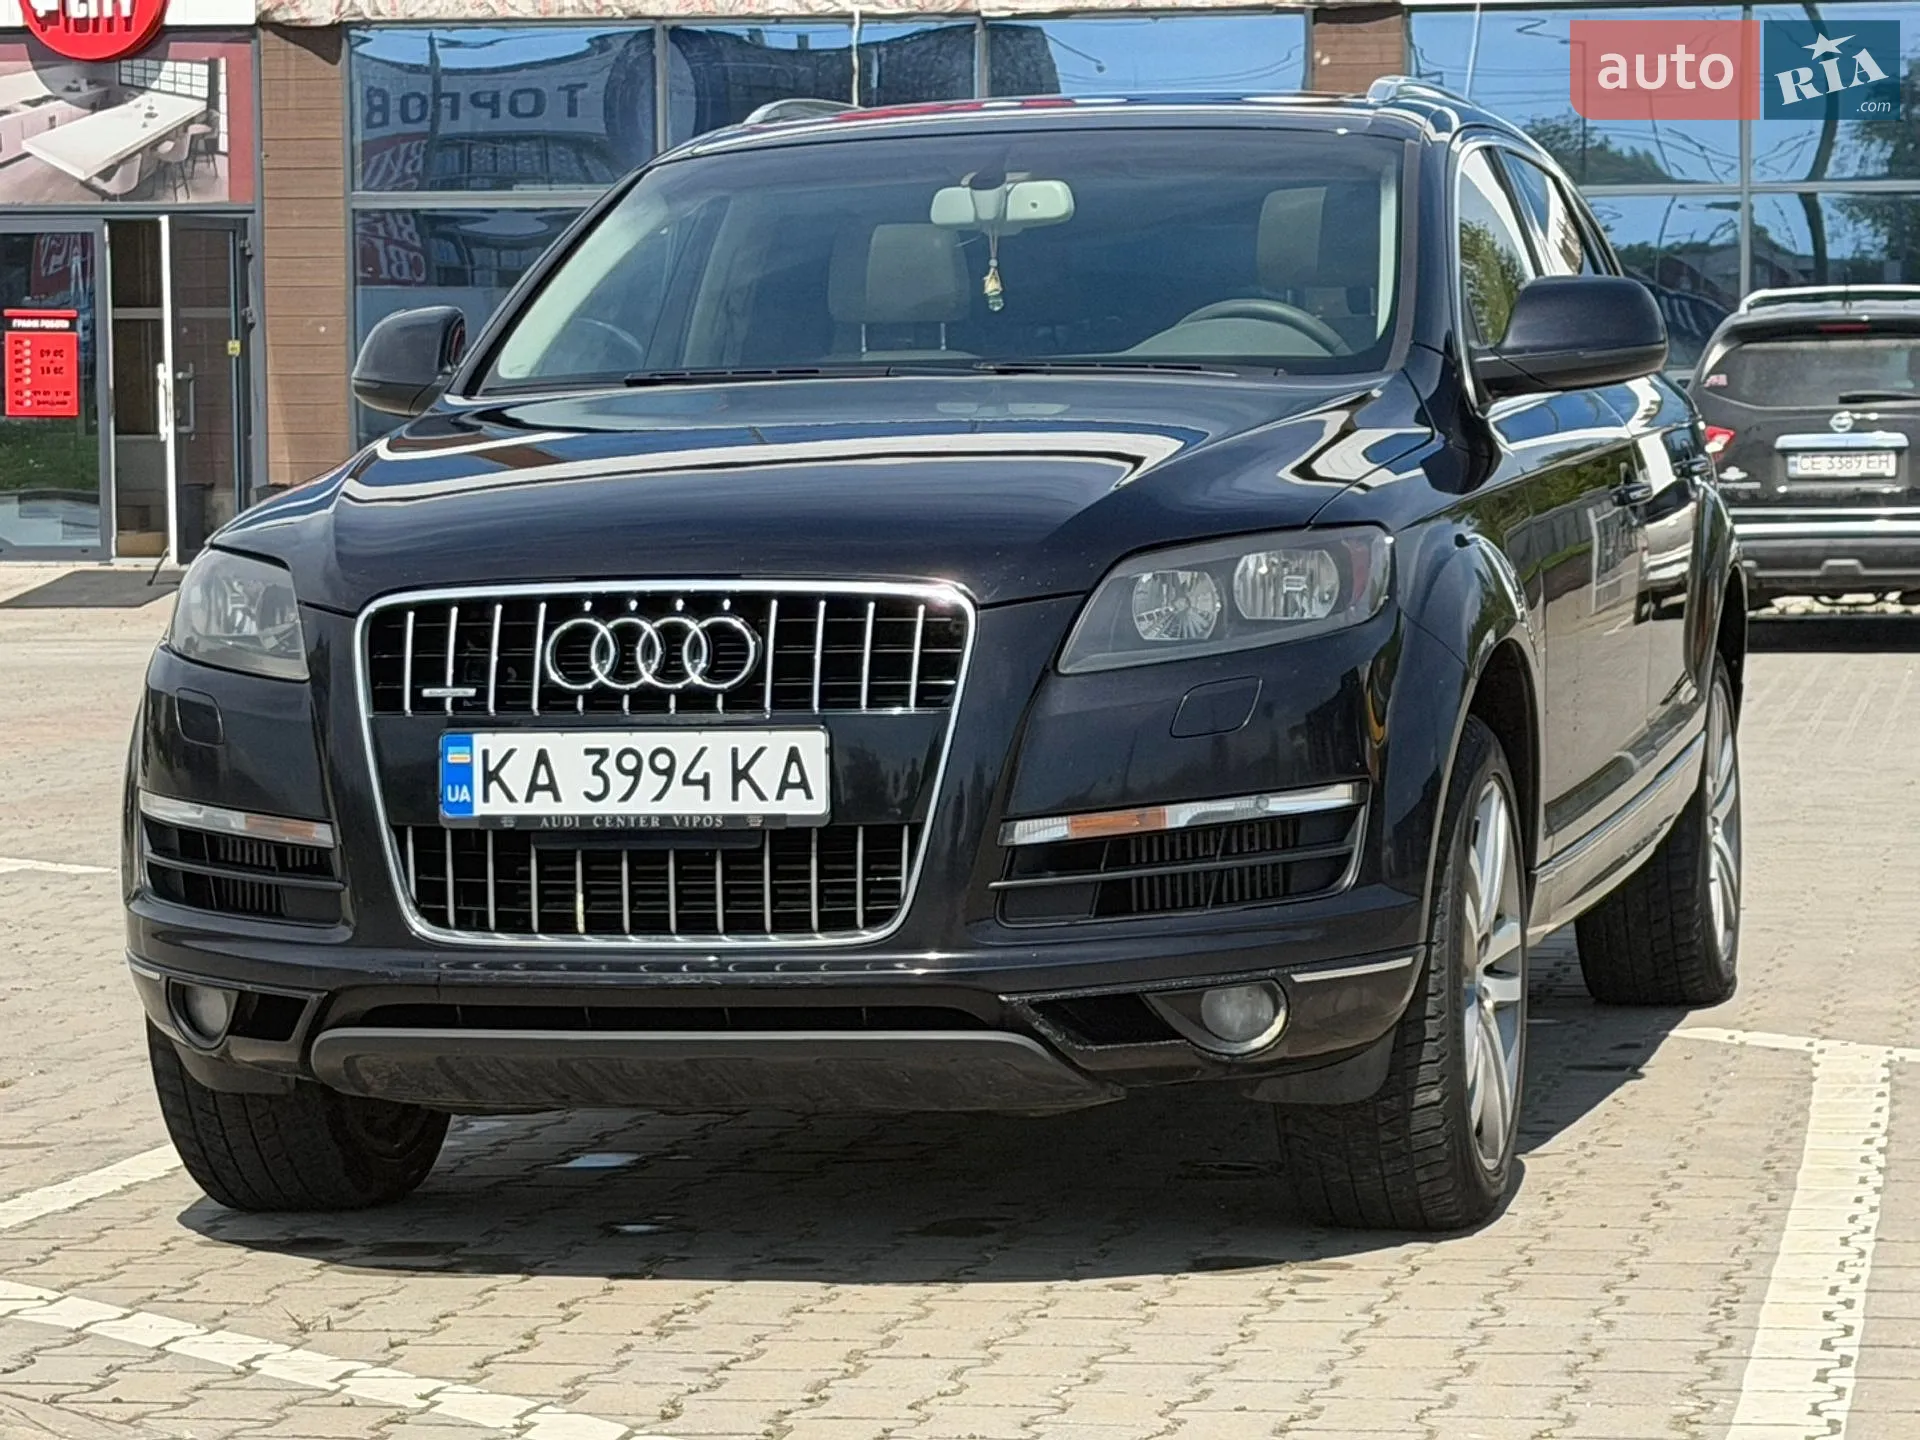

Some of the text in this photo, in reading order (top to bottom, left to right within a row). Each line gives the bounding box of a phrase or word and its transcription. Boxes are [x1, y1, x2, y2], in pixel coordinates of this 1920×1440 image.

[482, 746, 815, 804] KA 3994 KA
[447, 785, 471, 802] UA
[539, 814, 725, 829] AUDI CENTER VIPOS
